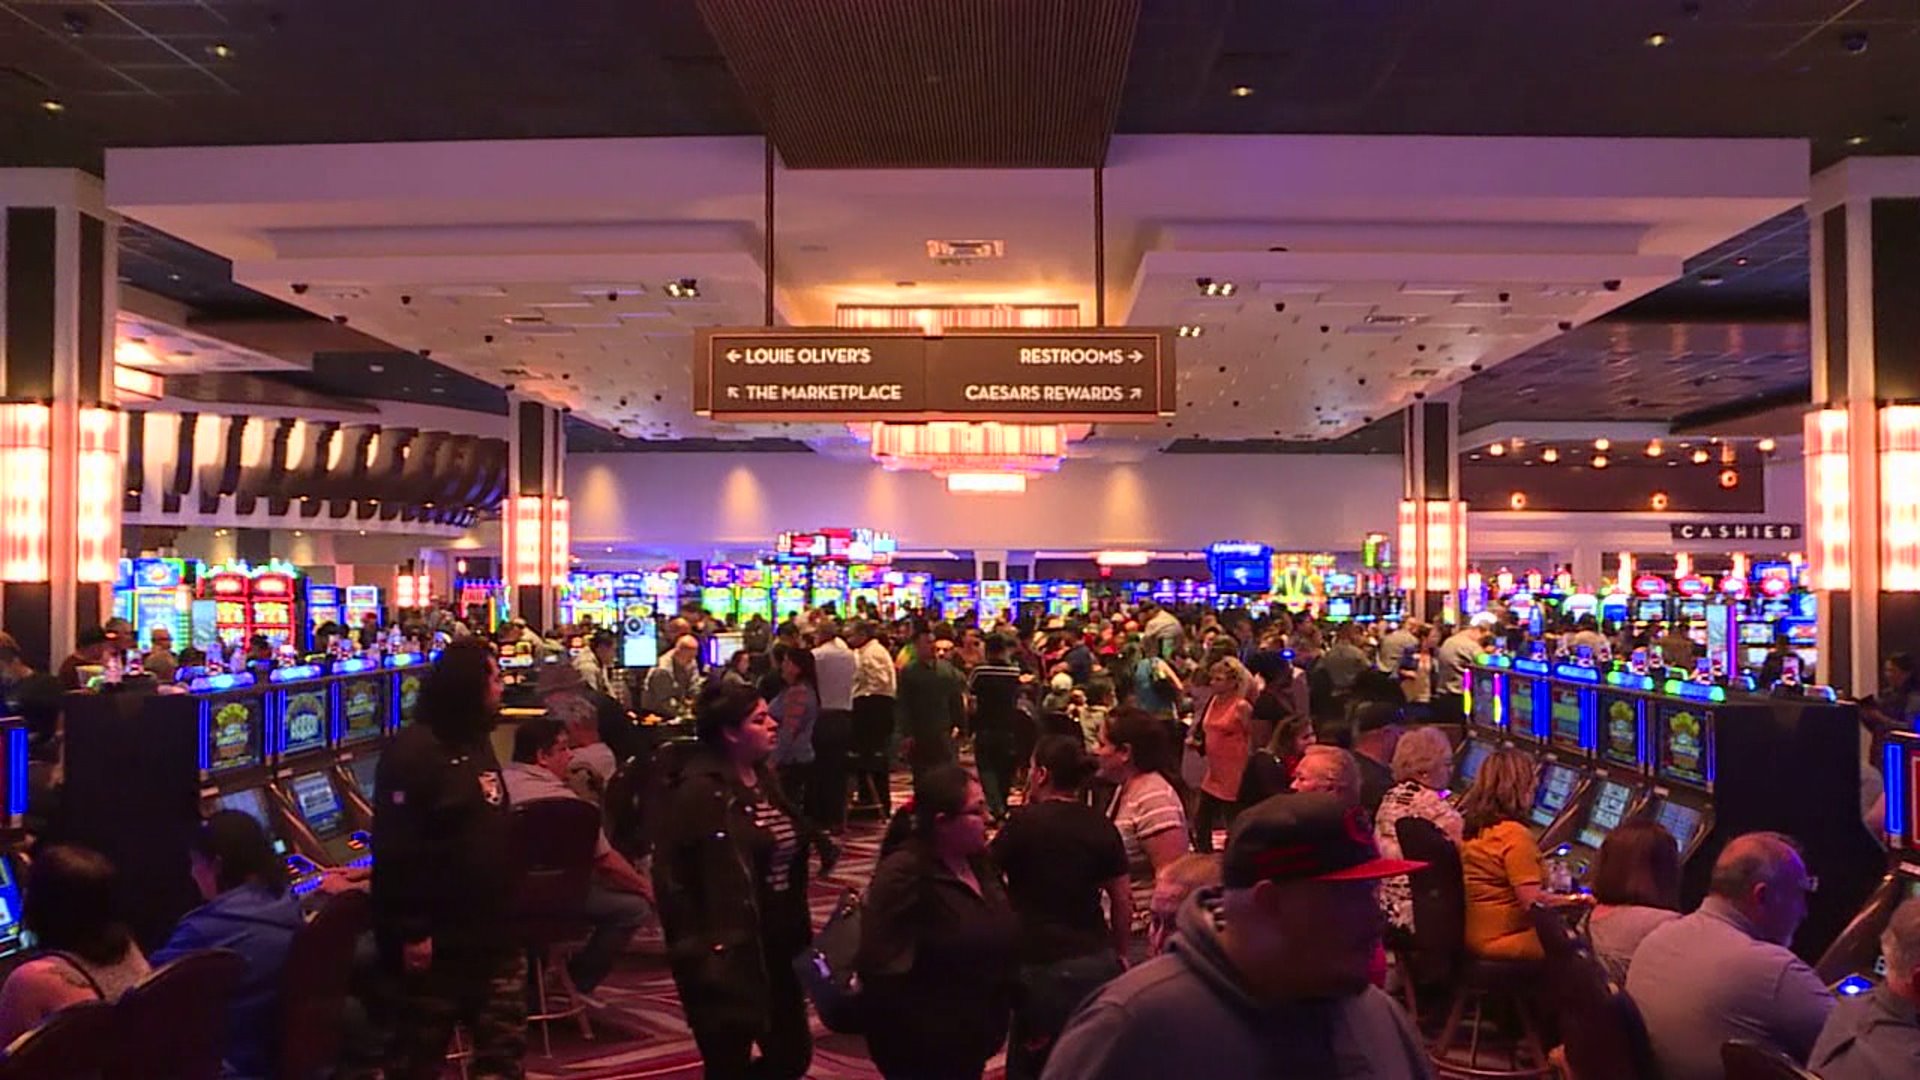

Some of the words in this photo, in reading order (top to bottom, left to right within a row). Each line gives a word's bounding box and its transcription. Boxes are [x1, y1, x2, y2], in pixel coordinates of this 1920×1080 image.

[745, 347, 795, 364] LOUIE
[797, 347, 872, 364] OLIVER'S
[1019, 347, 1124, 364] RESTROOMS
[745, 384, 778, 400] THE
[781, 384, 901, 400] MARKETPLACE
[965, 384, 1041, 400] CAESARS
[1043, 384, 1124, 400] REWARDS
[1680, 525, 1792, 539] CASHIER
